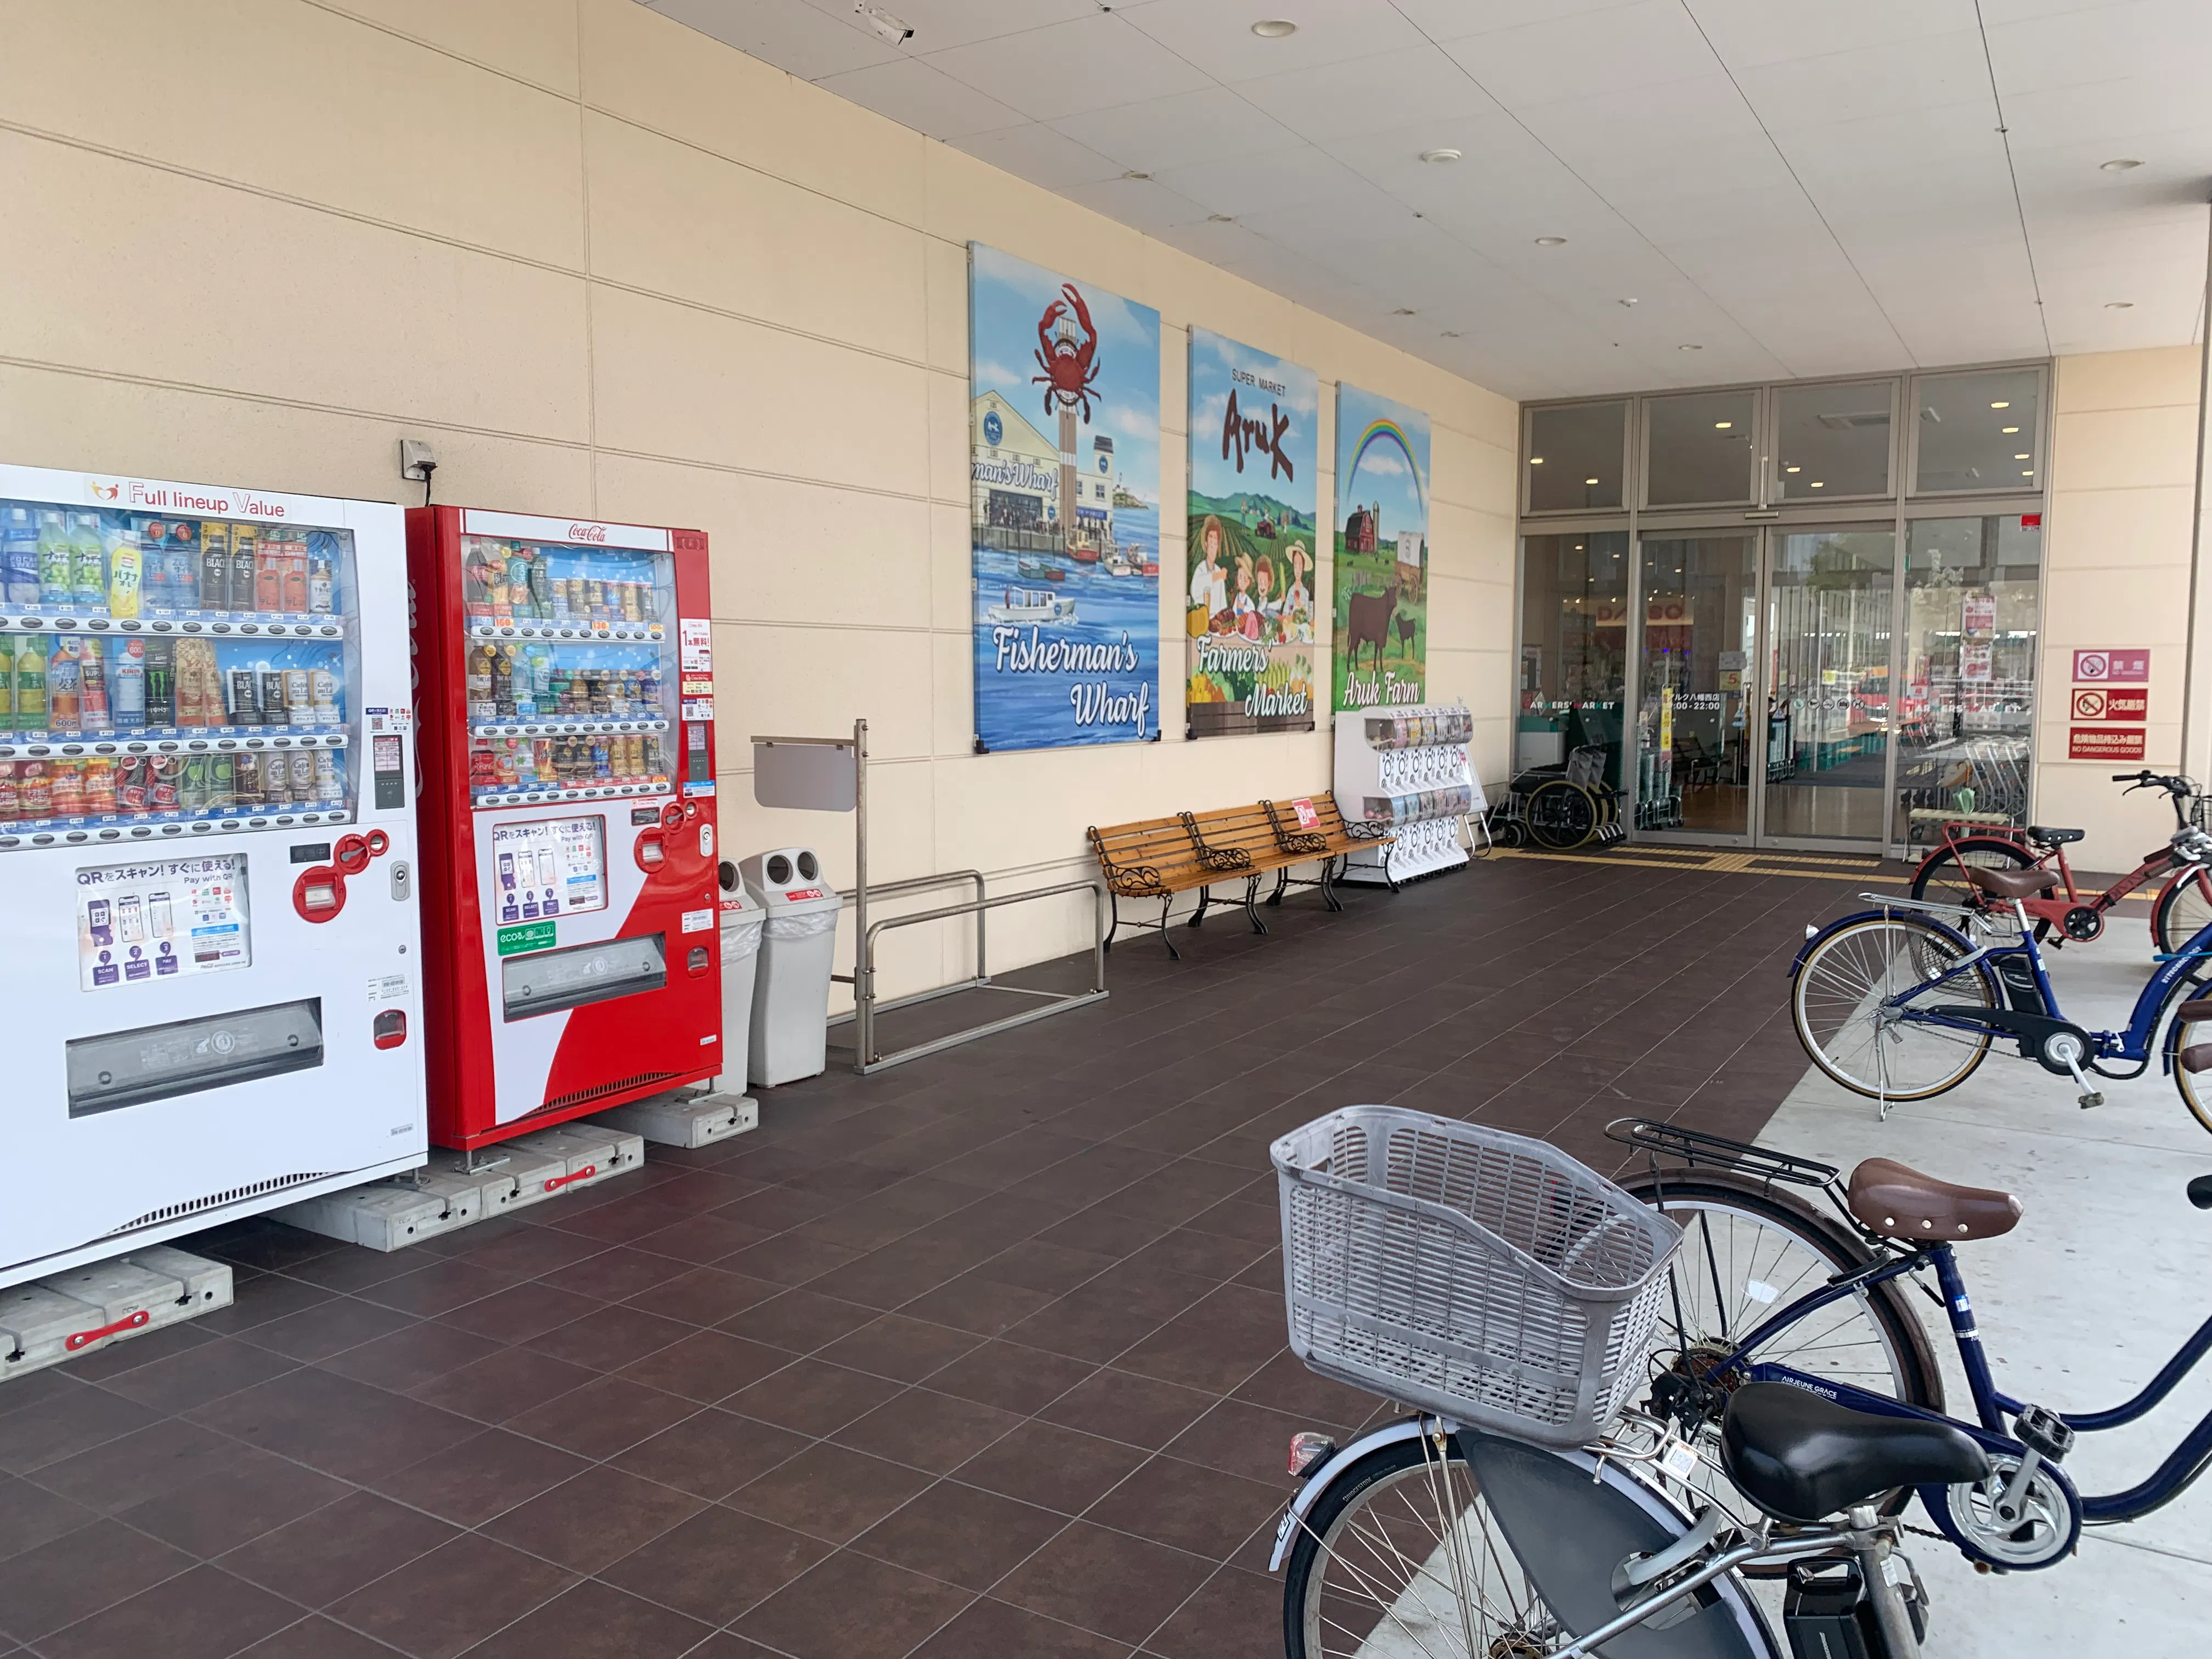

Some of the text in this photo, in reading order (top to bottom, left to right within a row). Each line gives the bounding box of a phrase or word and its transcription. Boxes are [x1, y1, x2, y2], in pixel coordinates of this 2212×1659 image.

[1232, 368, 1285, 397] SUPER MARKET
[128, 481, 285, 517] Full lineup Value
[1012, 462, 1058, 500] Wharf
[992, 624, 1139, 673] Fisherman's
[1197, 634, 1273, 673] Farmers'
[1245, 682, 1308, 718] Market
[1344, 671, 1420, 707] Aruk Farm
[2108, 699, 2145, 711] 火気厳禁
[1070, 680, 1150, 738] Wharf
[184, 876, 199, 884] Pay
[202, 874, 221, 882] with
[1781, 1376, 1814, 1390] AIRJEUNE
[1814, 1386, 1837, 1398] GRACE
[1342, 1477, 1372, 1502] BRIDGESTONE
